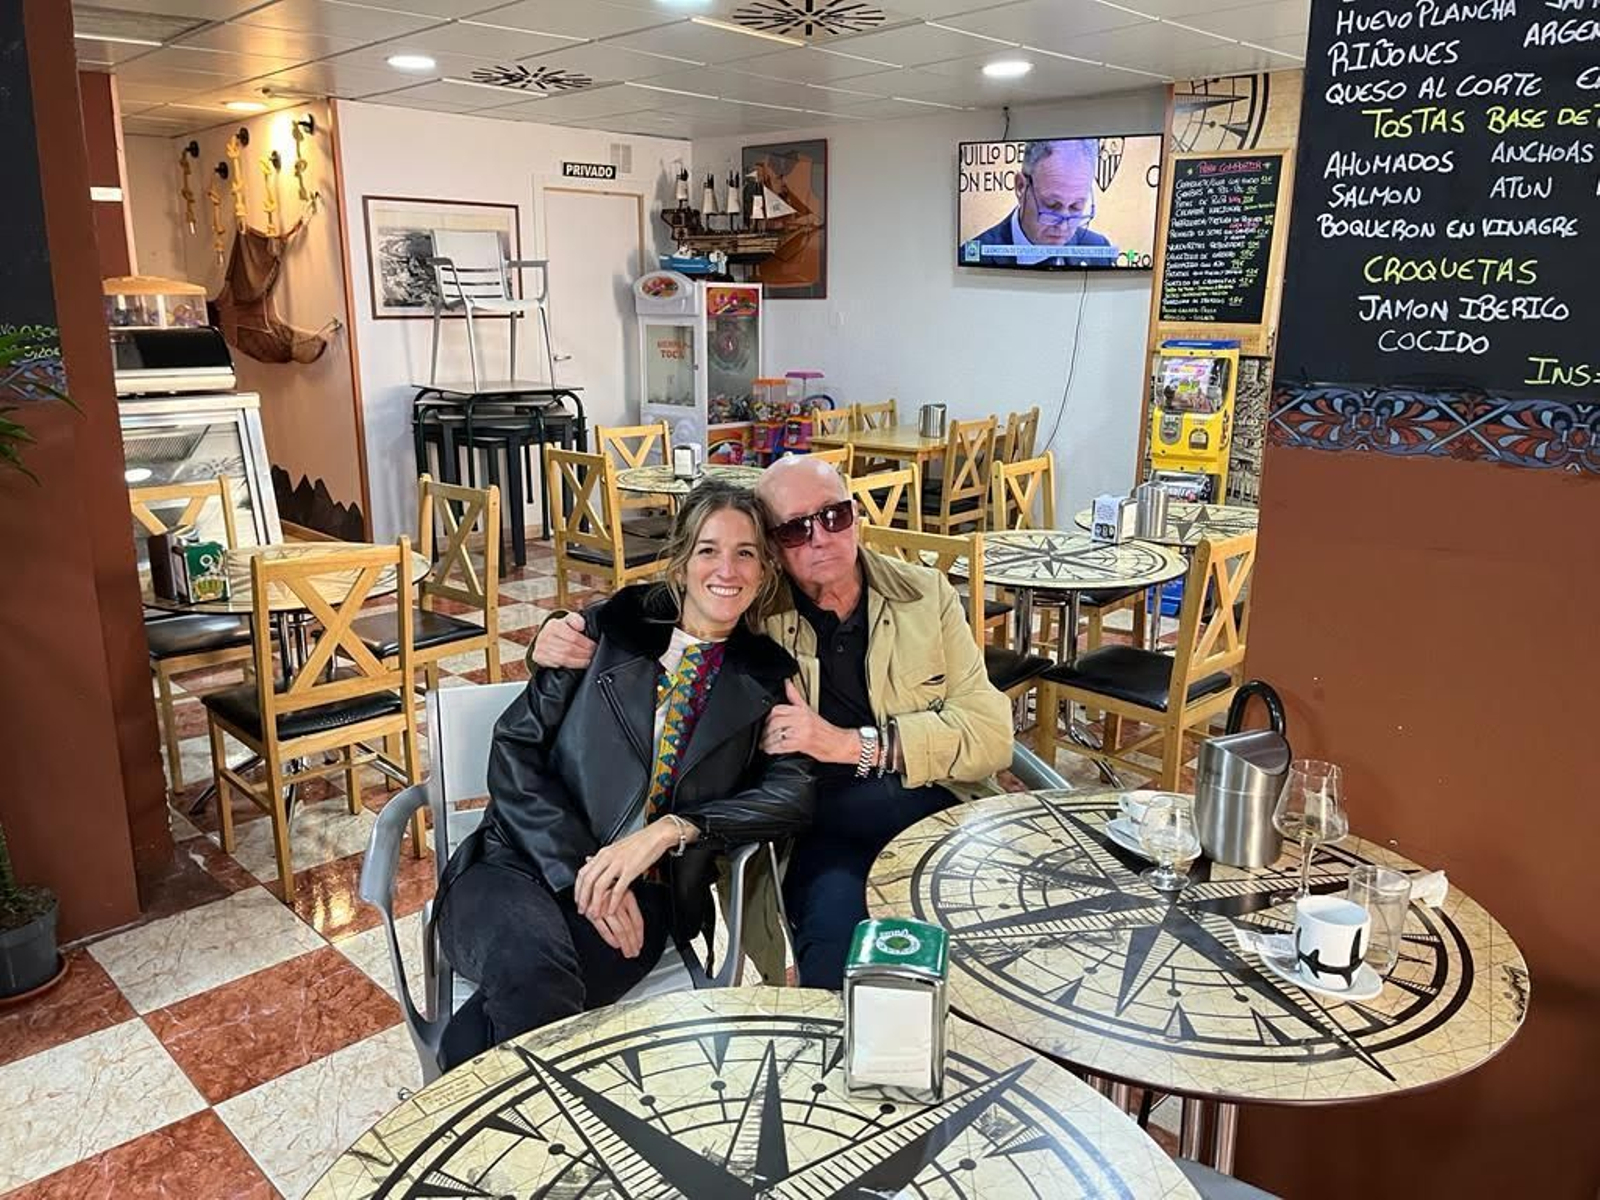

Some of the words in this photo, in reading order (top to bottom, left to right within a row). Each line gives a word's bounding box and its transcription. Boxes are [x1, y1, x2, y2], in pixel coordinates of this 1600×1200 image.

[1336, 10, 1413, 36] HUEVO
[1416, 0, 1517, 29] PLANCHA
[1327, 38, 1461, 77] RIÑONES
[1325, 80, 1407, 105] QUESO
[1417, 77, 1447, 100] AL
[1455, 72, 1543, 97] CORTE
[1361, 107, 1465, 138] TOSTAS
[1486, 106, 1548, 133] BASE
[1557, 108, 1592, 126] DE
[1323, 151, 1454, 179] AHUMADOS
[1490, 140, 1594, 164] ANCHOAS
[566, 164, 613, 177] PRIVADO
[1327, 183, 1421, 209] SALMON
[1489, 175, 1553, 199] ATUN
[1316, 213, 1436, 242] BOQUERON
[1446, 219, 1475, 239] EN
[1482, 216, 1578, 238] VINAGRE
[1363, 255, 1538, 285] CROQUETAS
[1358, 294, 1449, 322] JAMON
[1458, 294, 1570, 322] IBERICO
[1378, 330, 1490, 355] COCIDO
